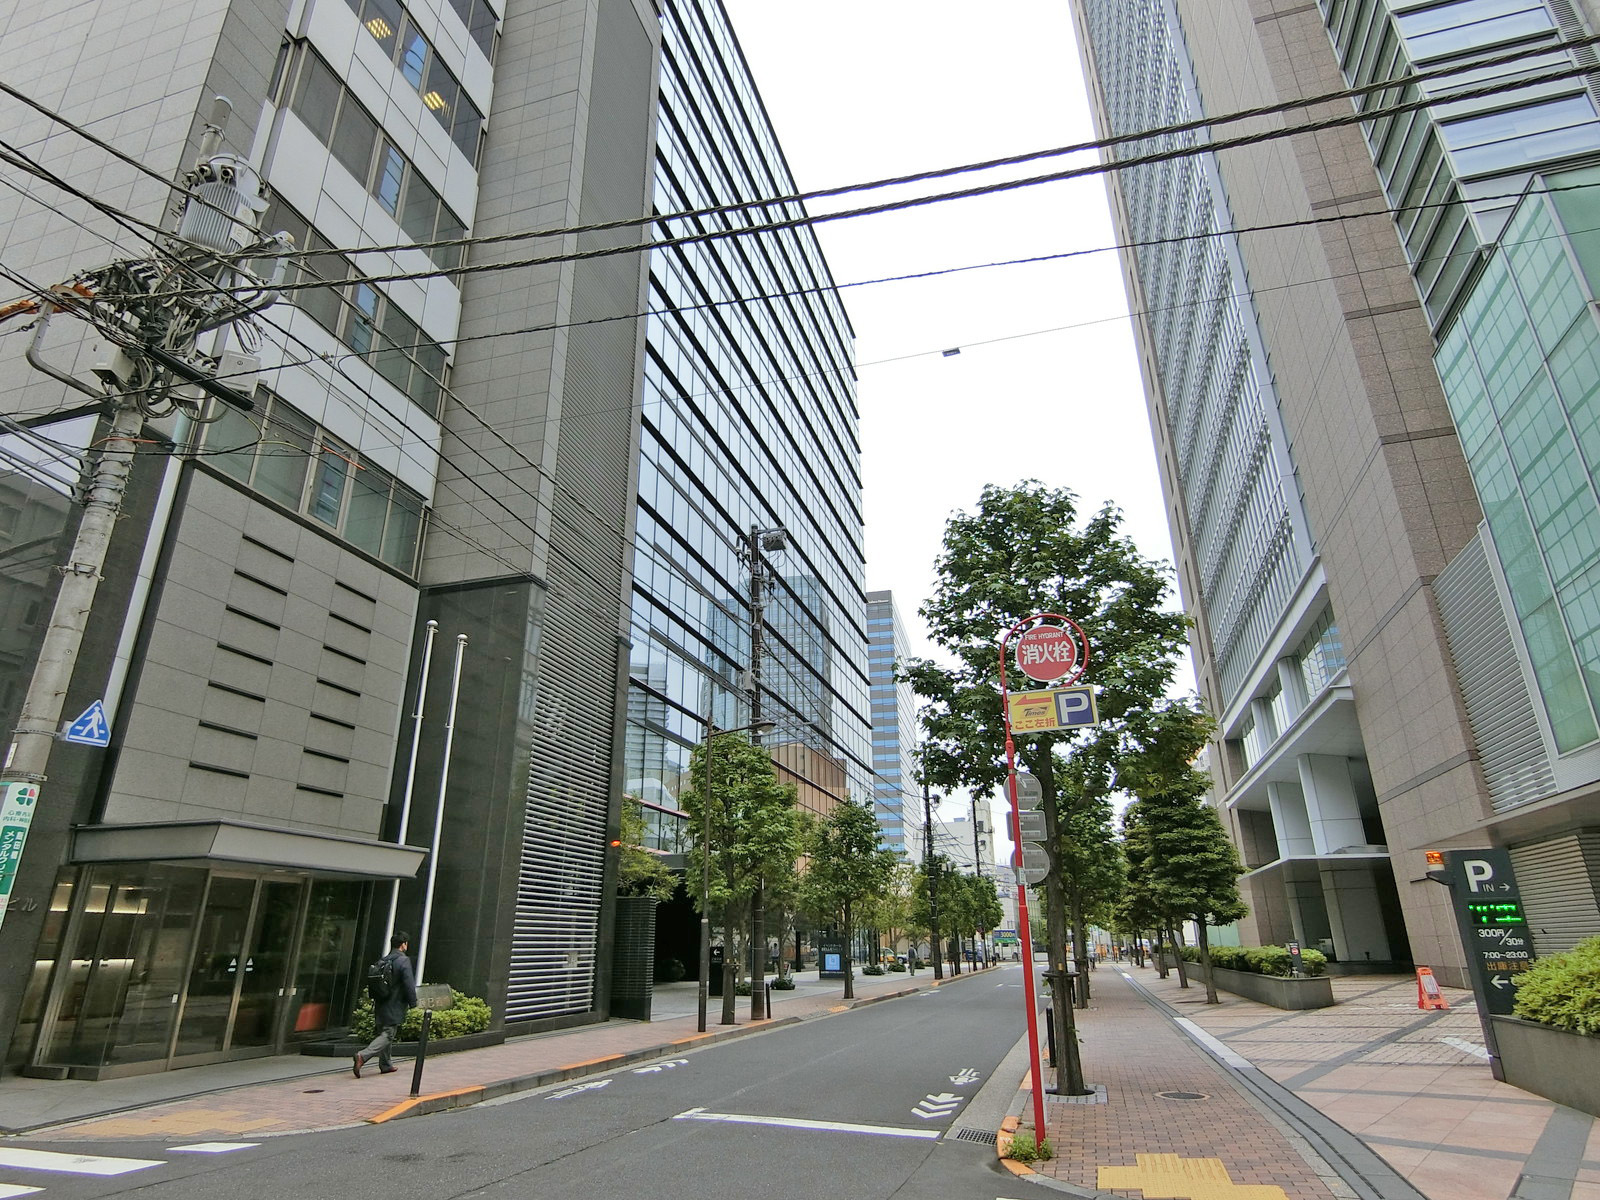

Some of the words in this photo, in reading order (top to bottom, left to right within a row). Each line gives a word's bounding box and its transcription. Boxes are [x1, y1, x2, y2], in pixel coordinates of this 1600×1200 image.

[1022, 641, 1072, 665] 消火栓
[1024, 706, 1048, 717] Times
[1058, 692, 1089, 724] P
[1015, 717, 1056, 730] ここ左折
[1464, 860, 1493, 892] P
[1482, 883, 1495, 892] IN
